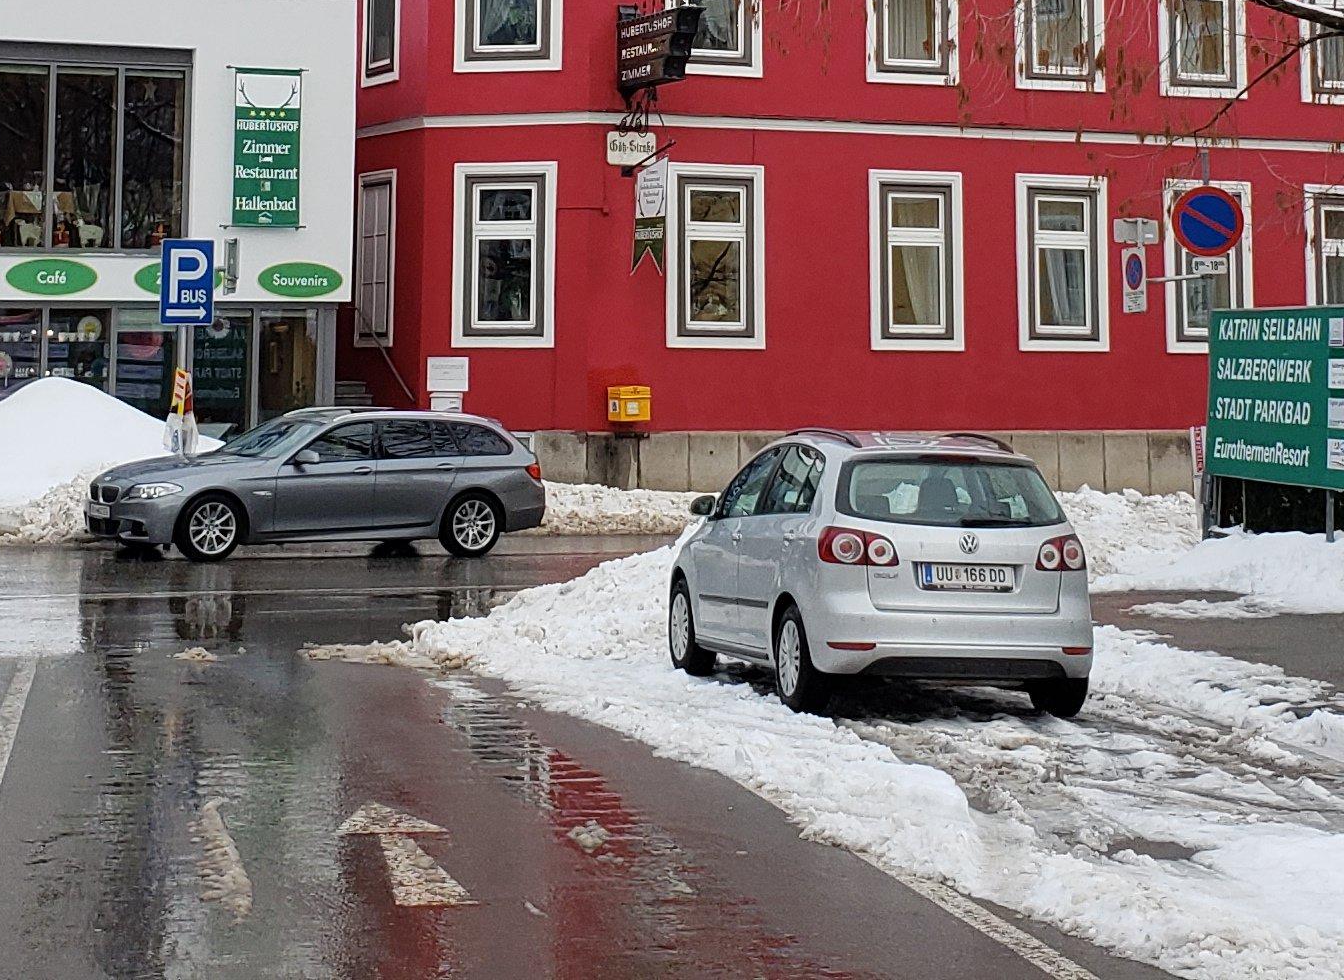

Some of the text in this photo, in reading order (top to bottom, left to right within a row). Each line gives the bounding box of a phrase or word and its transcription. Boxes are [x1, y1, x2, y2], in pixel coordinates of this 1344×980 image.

[621, 16, 673, 39] HUBERTUSHOF
[621, 64, 651, 80] ZIMMER
[236, 119, 299, 132] HUBERTUSHOF
[242, 139, 291, 154] Zimmer
[235, 165, 298, 180] Restaurant
[235, 196, 297, 211] Hallenbad
[36, 270, 67, 285] Café
[169, 248, 208, 304] P
[272, 273, 328, 287] Souvenirs
[180, 289, 207, 304] BUS
[1218, 319, 1259, 340] KATRIN
[1262, 318, 1322, 341] SEILBAHN
[1217, 357, 1312, 383] SALZBERGWERK
[1215, 397, 1311, 425] STADT PARKBAD
[1214, 437, 1310, 467] EurothermenResort
[936, 567, 1006, 583] UU 166 DD
